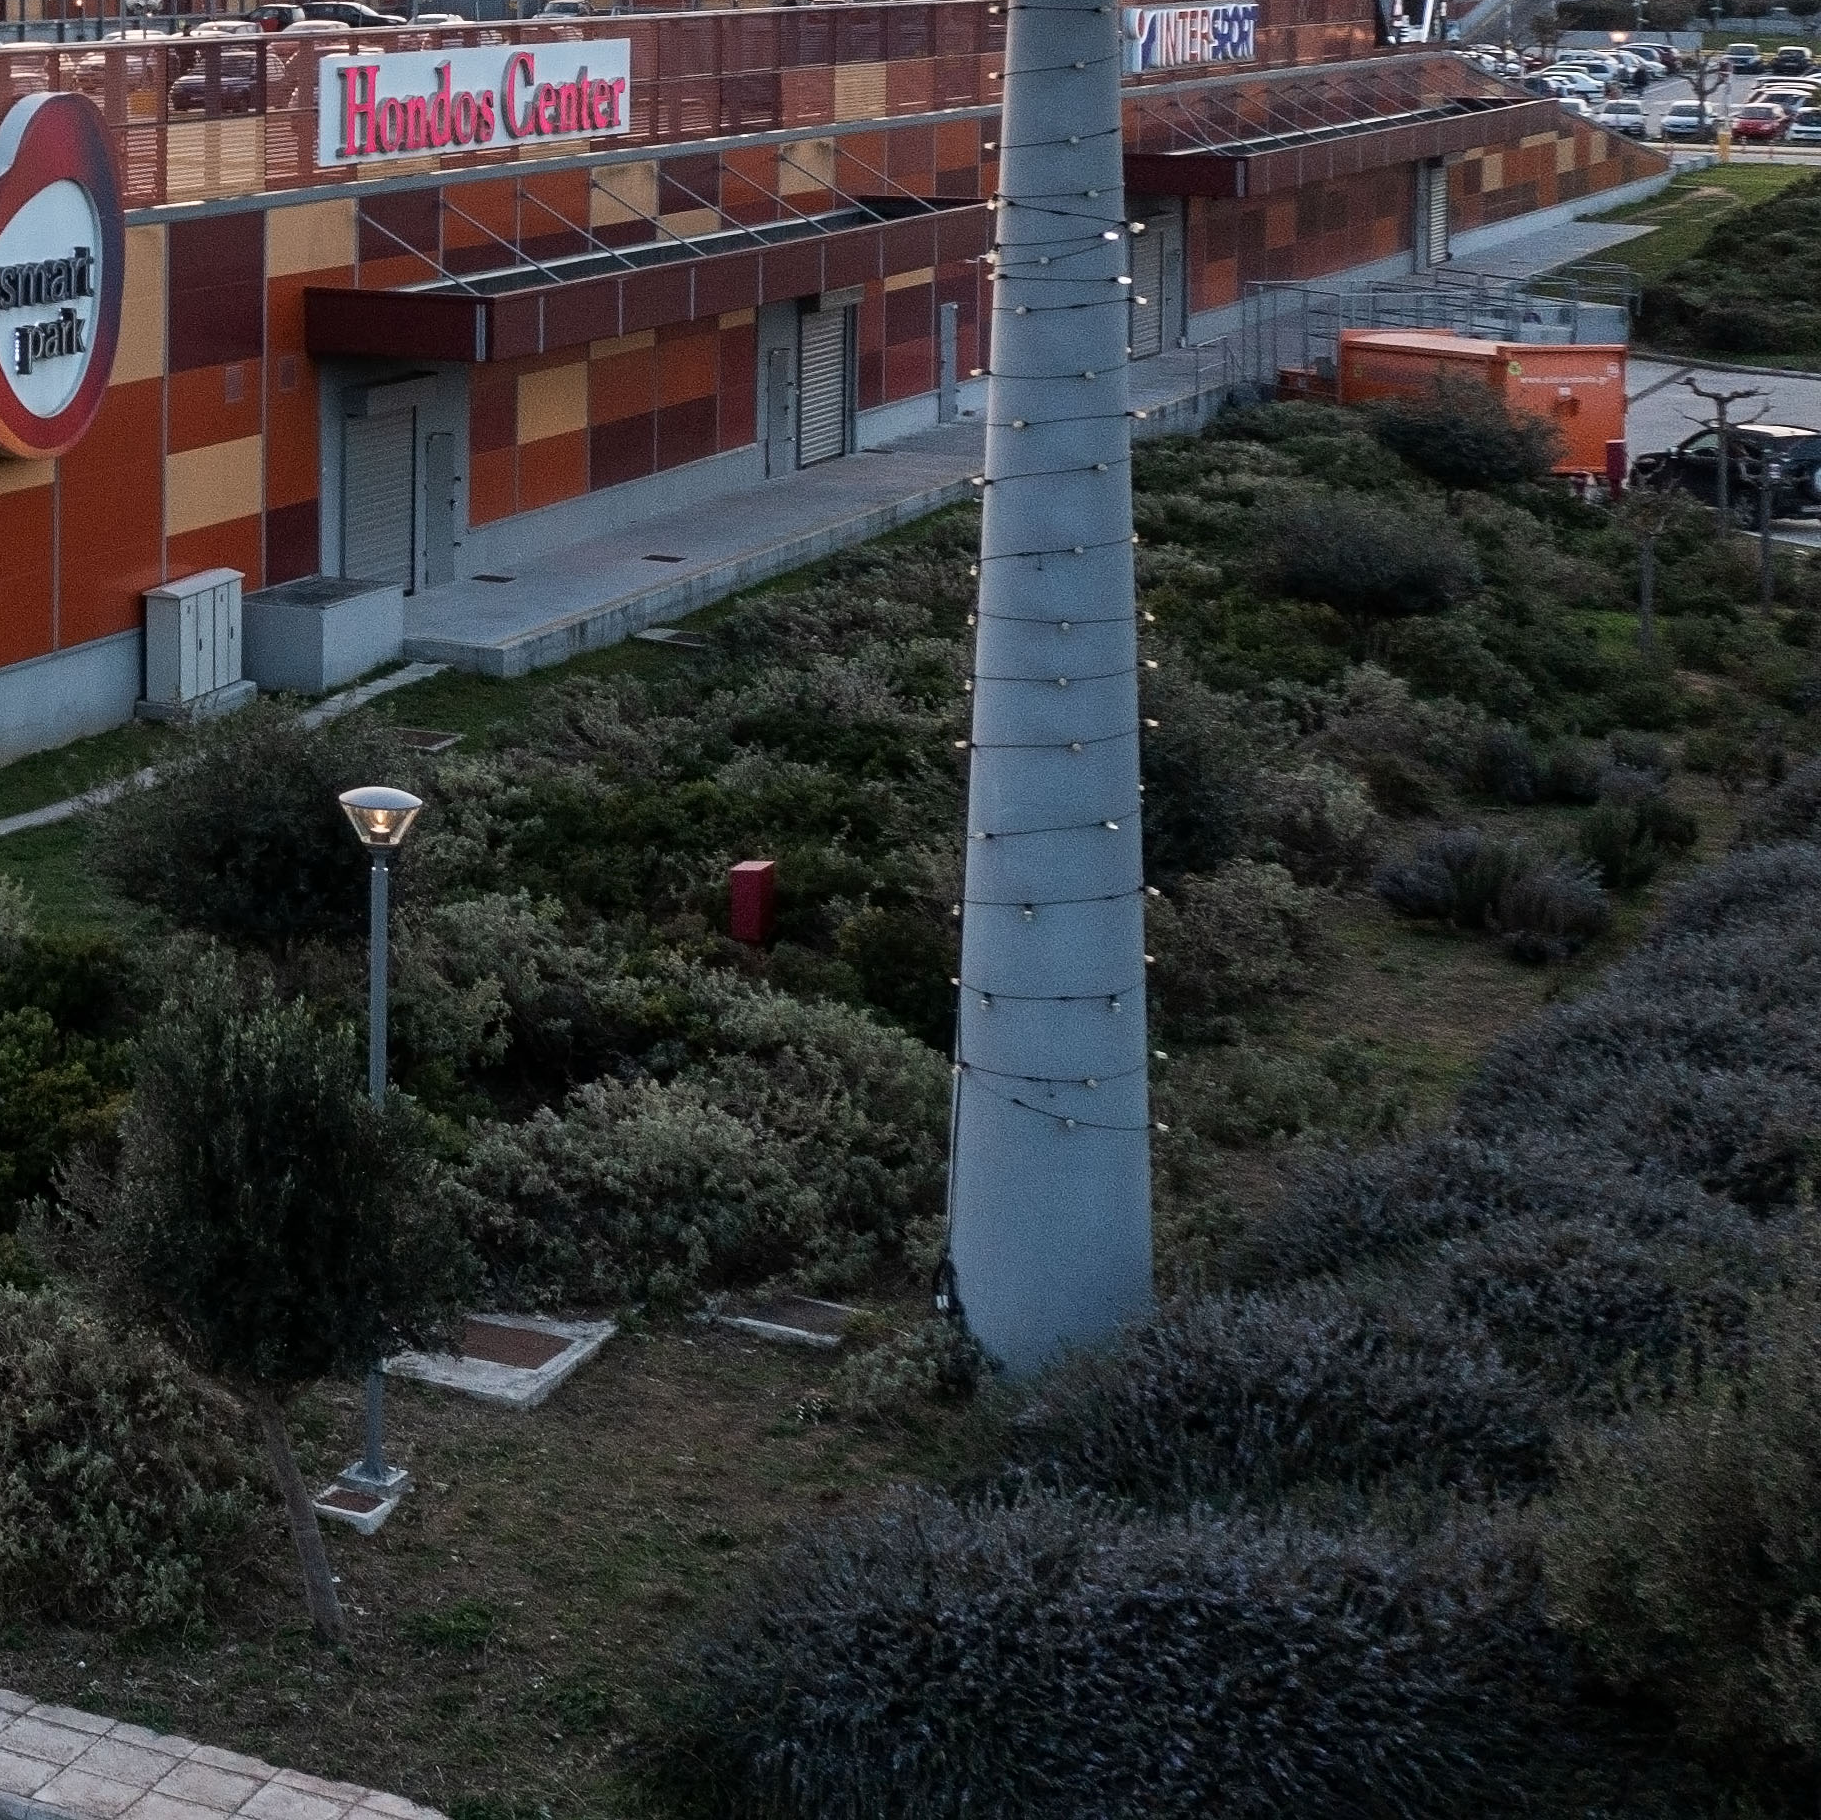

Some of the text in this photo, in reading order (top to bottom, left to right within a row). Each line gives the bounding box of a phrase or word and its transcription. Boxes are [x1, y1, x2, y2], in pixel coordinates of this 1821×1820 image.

[1159, 3, 1260, 67] INTERSPORT
[336, 51, 626, 158] Hondos Center
[14, 307, 87, 375] park
